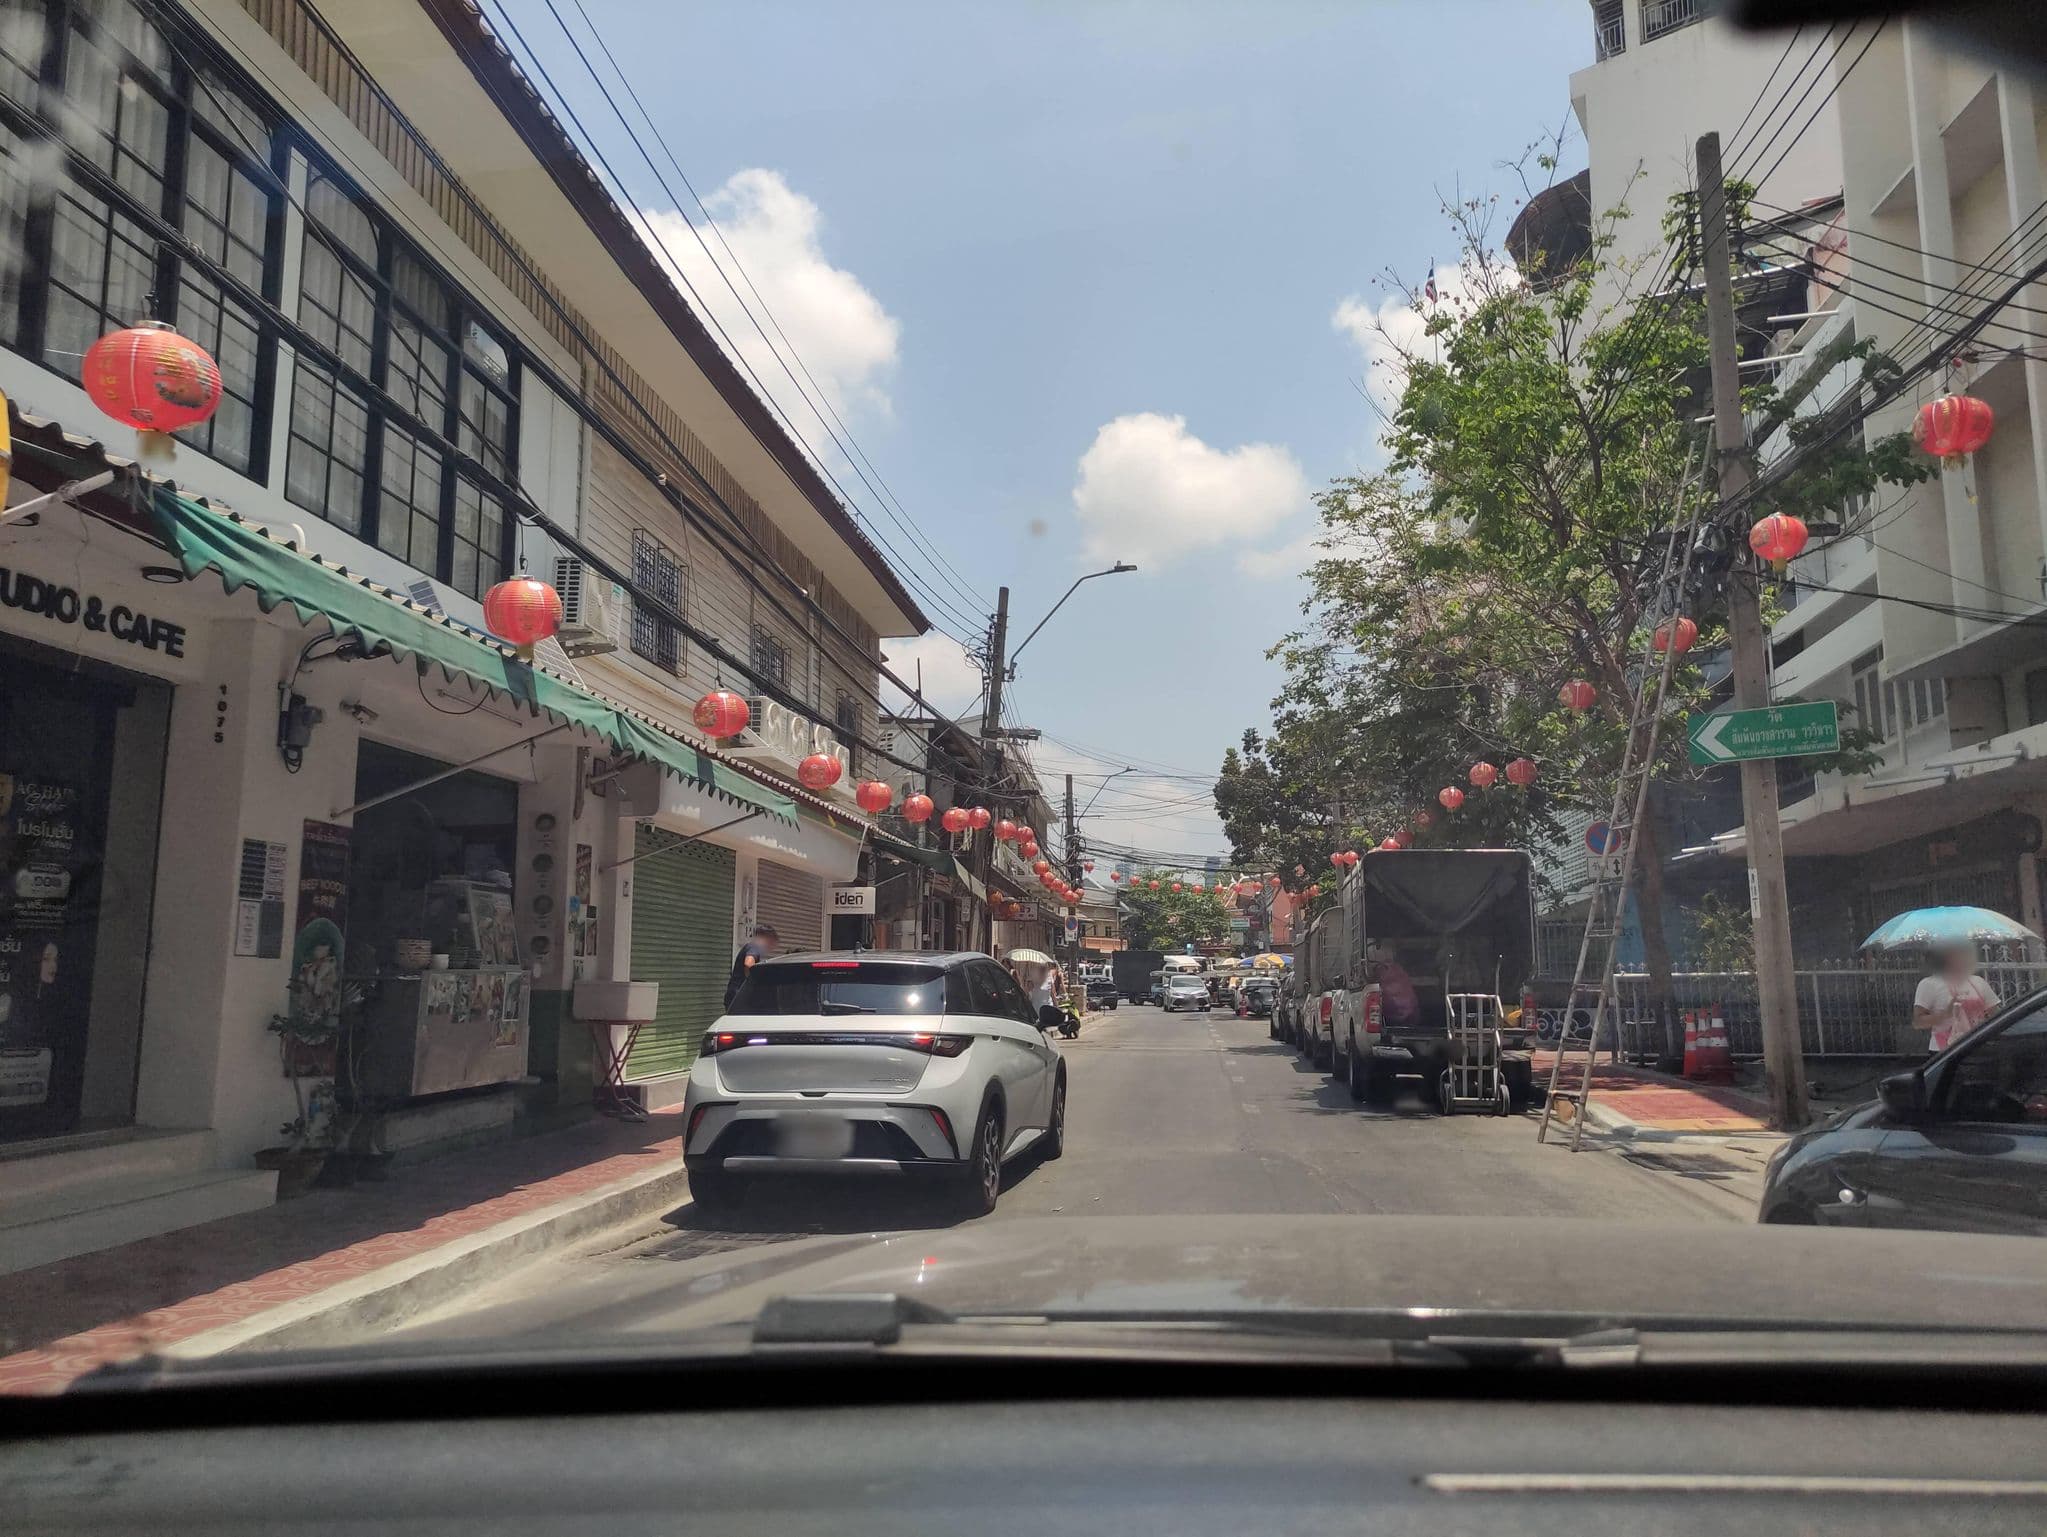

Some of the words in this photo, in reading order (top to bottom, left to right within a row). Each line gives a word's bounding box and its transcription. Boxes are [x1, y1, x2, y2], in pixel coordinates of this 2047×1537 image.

[83, 596, 107, 632] &
[110, 606, 186, 658] CAFE
[1767, 709, 1783, 723] วัด
[835, 892, 864, 905] iden
